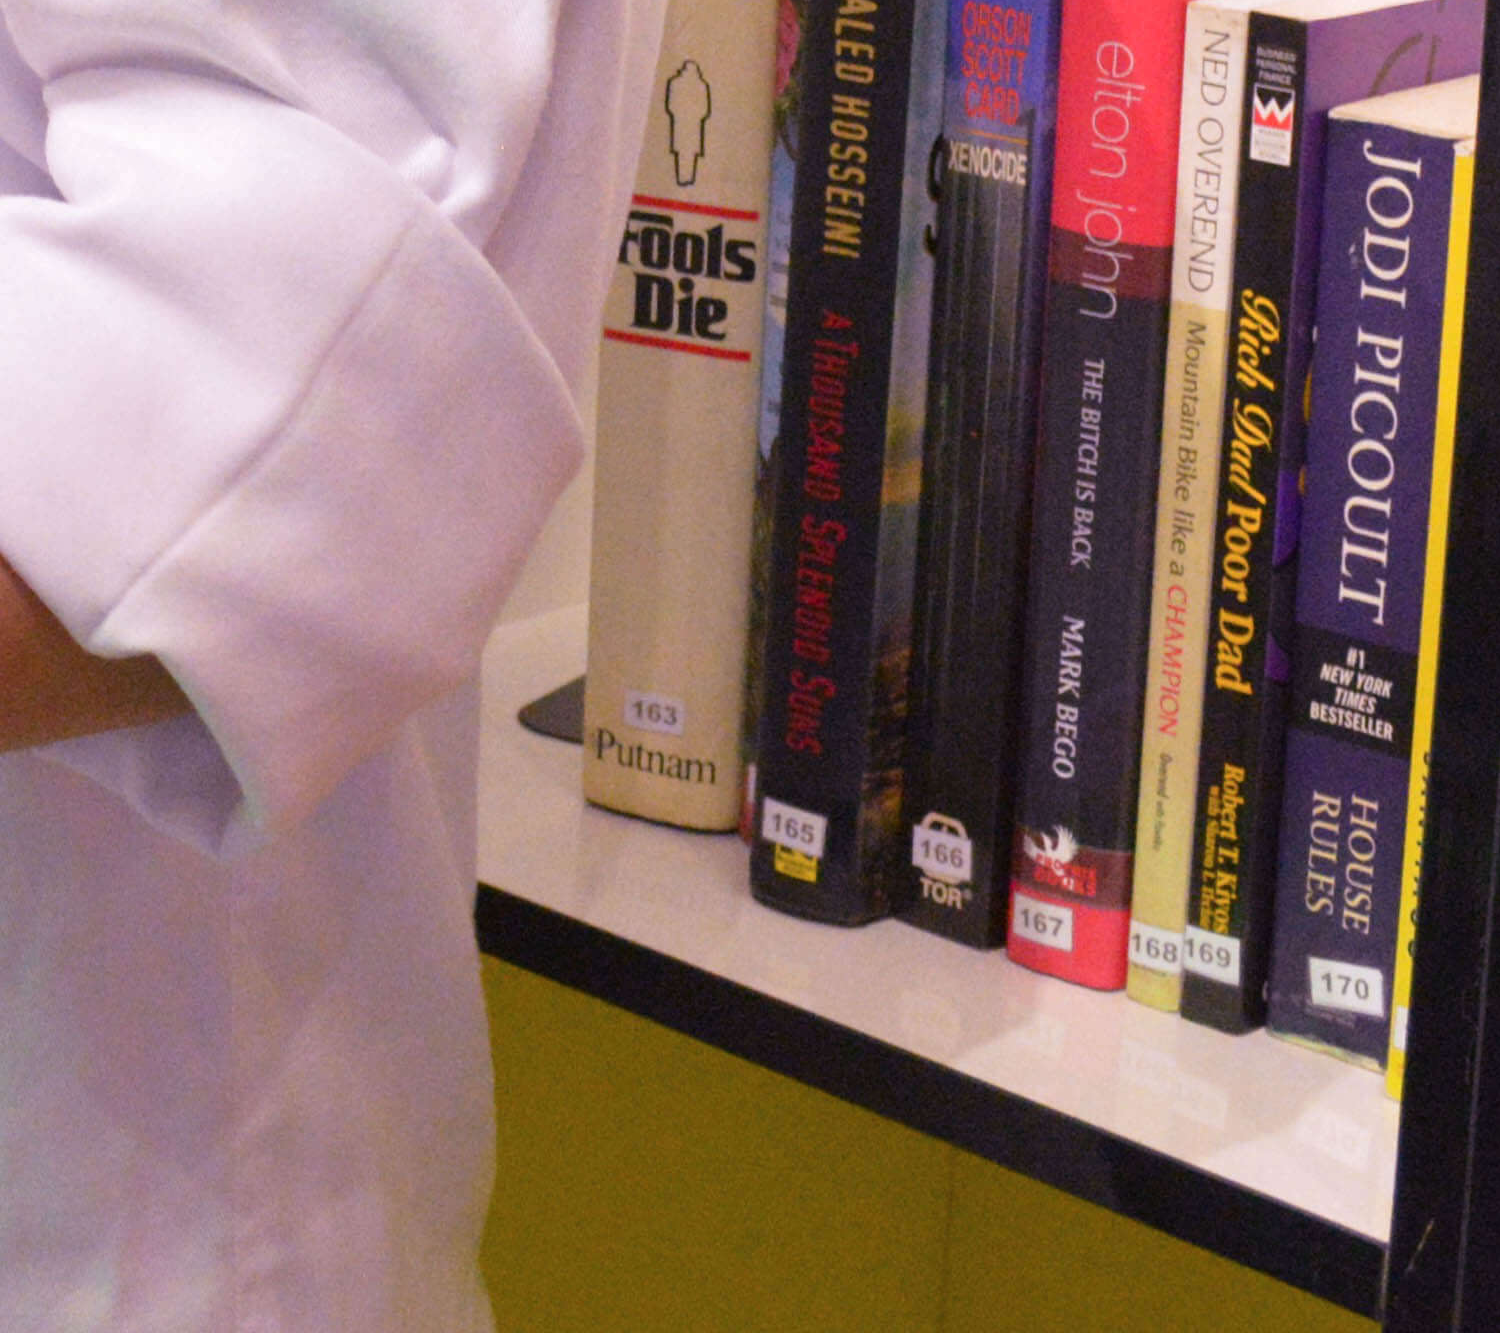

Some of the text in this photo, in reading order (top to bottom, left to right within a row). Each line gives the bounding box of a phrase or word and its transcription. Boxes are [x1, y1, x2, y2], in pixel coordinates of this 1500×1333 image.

[961, 0, 1033, 47] ORSON
[961, 41, 1028, 87] SCOTT
[964, 80, 1020, 127] CARD
[822, 94, 873, 260] HOSSEINI
[949, 139, 1028, 186] XENOCIDE
[1076, 40, 1146, 321] elton john
[1187, 29, 1231, 294] NED OVEREND
[630, 274, 728, 341] Die
[1180, 320, 1206, 443] Mountain
[1338, 139, 1422, 625] JODI PICOULT
[1069, 358, 1105, 571] THE BITCH IS BACK
[1174, 447, 1199, 503] Bike
[1215, 287, 1282, 699] Rich Dad Poor Dad
[787, 309, 860, 756] A THOUSAND SPLENDID SUNS
[1169, 509, 1196, 557] like
[1158, 584, 1188, 738] CHAMPION
[1320, 663, 1392, 697] NEW YORK
[1346, 647, 1365, 669] #1
[632, 699, 679, 727] 163
[1051, 614, 1086, 779] MARK BEGO
[1333, 685, 1376, 714] TIMES
[1309, 701, 1394, 742] BESTSELLER
[594, 727, 718, 786] Putnam
[1219, 762, 1246, 841] Robert
[771, 811, 815, 845] 165
[920, 838, 965, 869] 166
[1217, 841, 1240, 864] T.
[1304, 789, 1342, 916] RULES
[1342, 793, 1379, 935] HOUSE
[1021, 908, 1064, 937] 167
[1132, 933, 1178, 963] 168
[1184, 938, 1231, 968] 169
[1320, 971, 1370, 1000] 170
